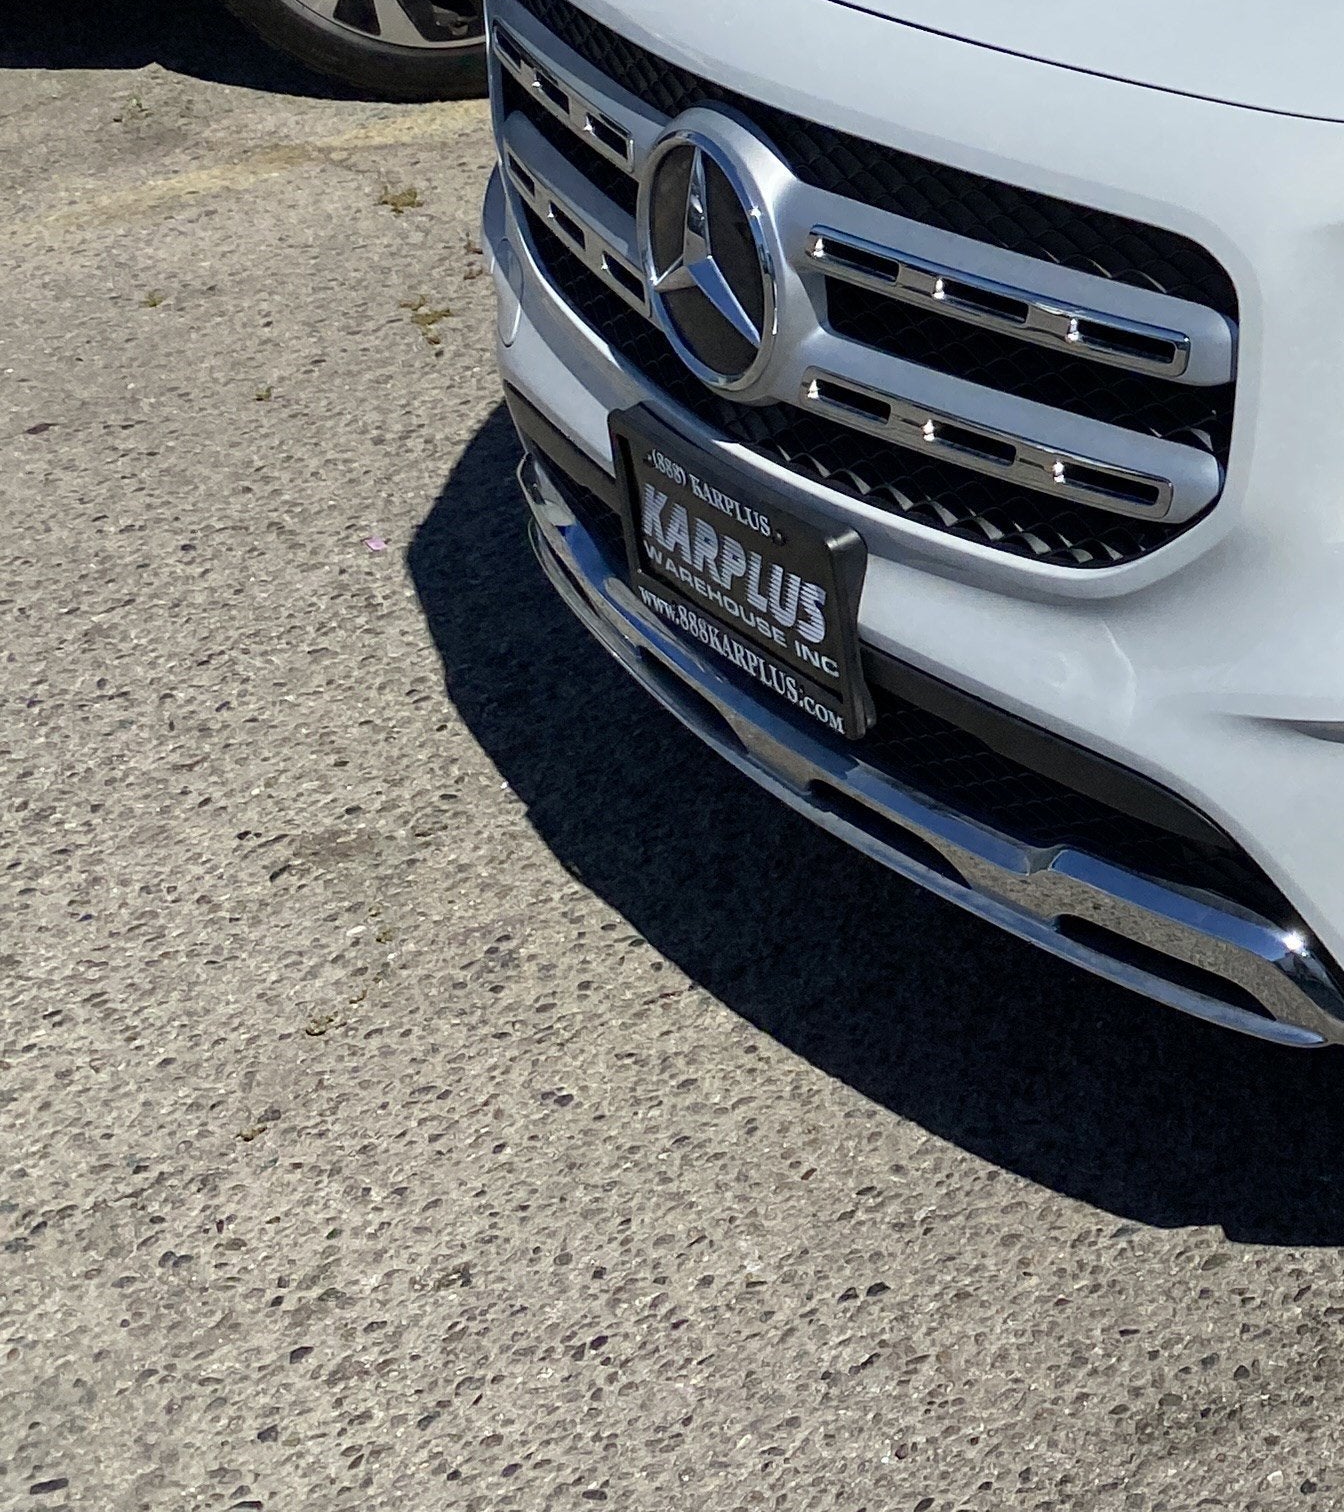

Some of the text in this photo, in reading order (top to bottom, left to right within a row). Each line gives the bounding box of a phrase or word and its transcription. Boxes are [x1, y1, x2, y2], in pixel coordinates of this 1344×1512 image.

[651, 448, 771, 537] (888) KARPLUS
[642, 483, 827, 644] KARPLUS
[643, 541, 840, 678] WAREHOUSE INC
